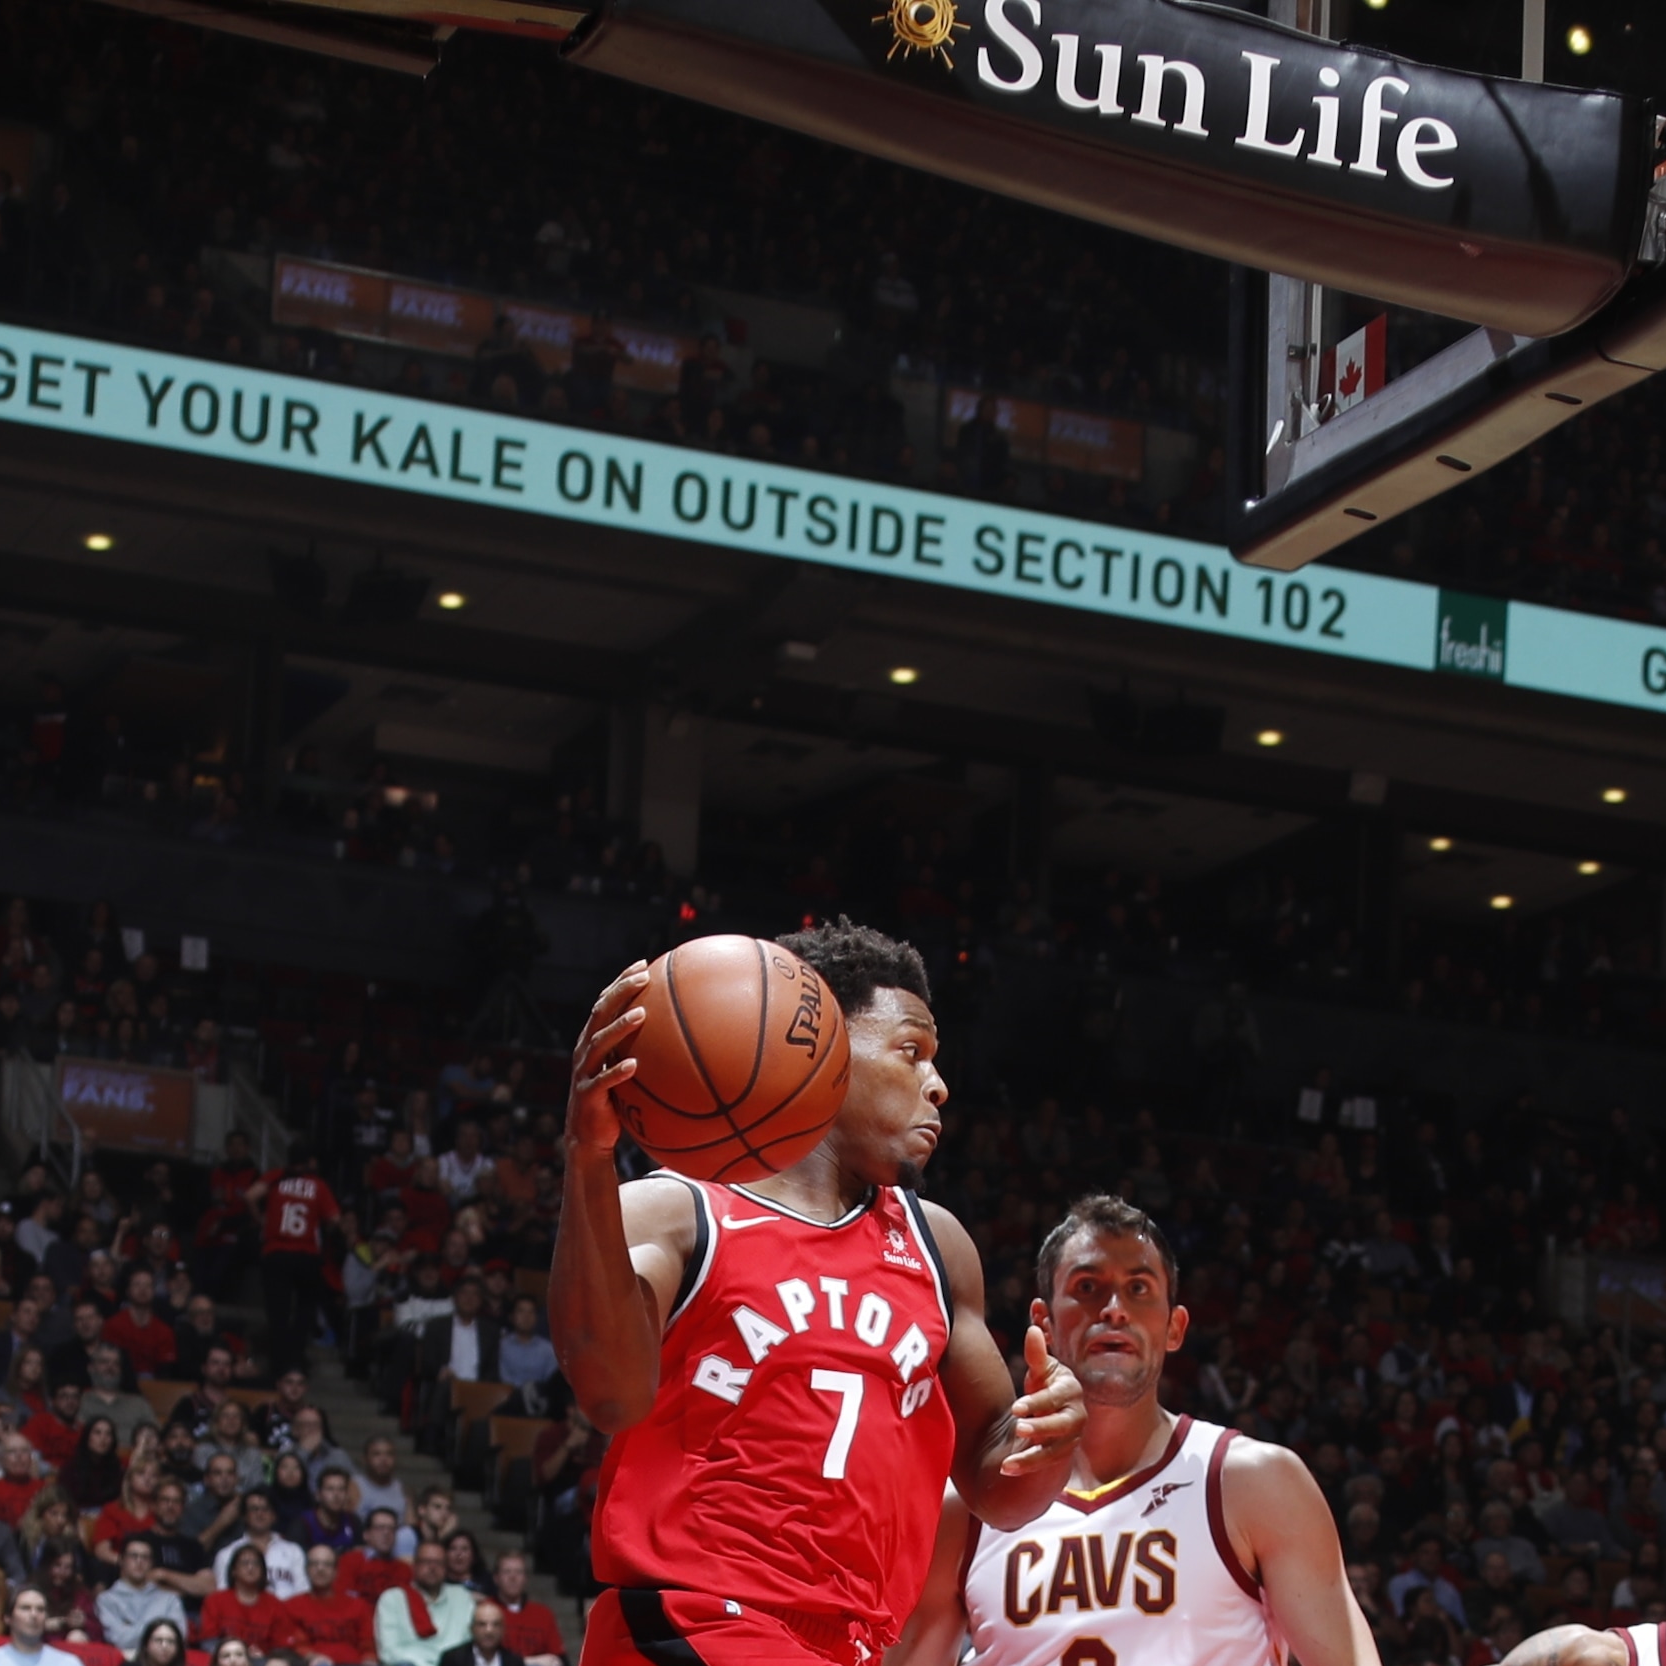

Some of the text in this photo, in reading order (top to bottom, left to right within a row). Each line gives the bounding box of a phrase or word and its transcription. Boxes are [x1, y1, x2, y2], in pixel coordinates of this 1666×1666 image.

[977, 0, 1459, 189] Sun Life
[137, 373, 321, 456] YOUR
[351, 412, 527, 493] KALE
[556, 450, 644, 513] ON
[672, 471, 946, 567] OUTSIDE
[973, 525, 1231, 619] SECTION
[1256, 577, 1347, 640] 102
[1439, 616, 1503, 672] freshii
[279, 1201, 310, 1237] 16
[883, 1250, 904, 1265] Sun
[690, 1275, 933, 1420] RAPTORS
[810, 1367, 865, 1480] 7
[1003, 1528, 1178, 1628] CAVS
